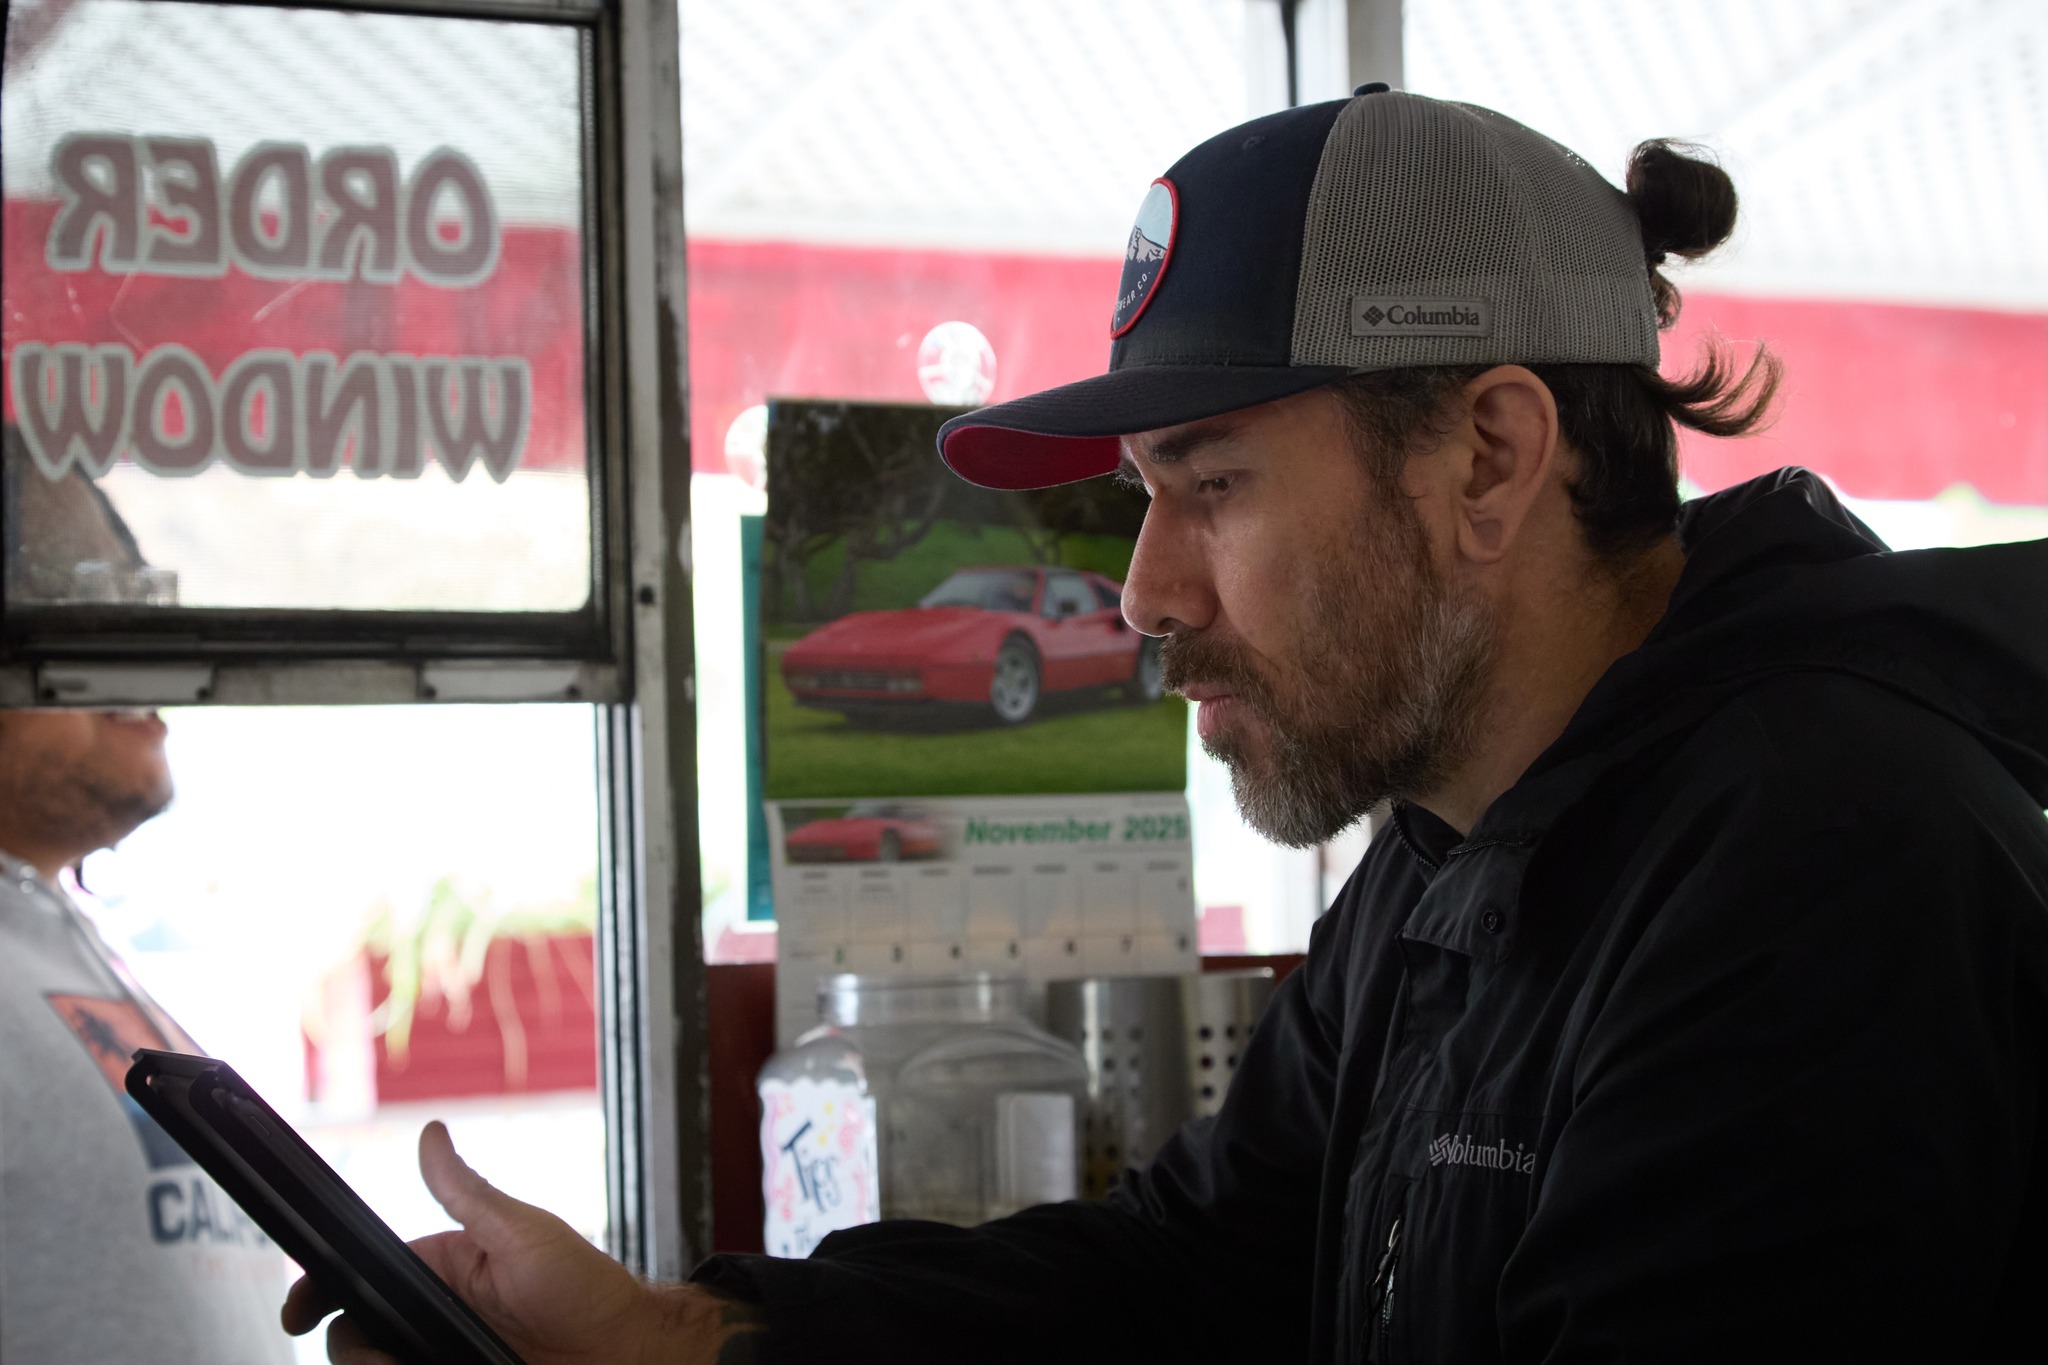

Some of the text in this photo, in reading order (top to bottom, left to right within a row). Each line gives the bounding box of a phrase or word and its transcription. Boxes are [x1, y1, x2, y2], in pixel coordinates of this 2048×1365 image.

[1386, 304, 1480, 326] Columbia
[965, 814, 1187, 844] November 2025
